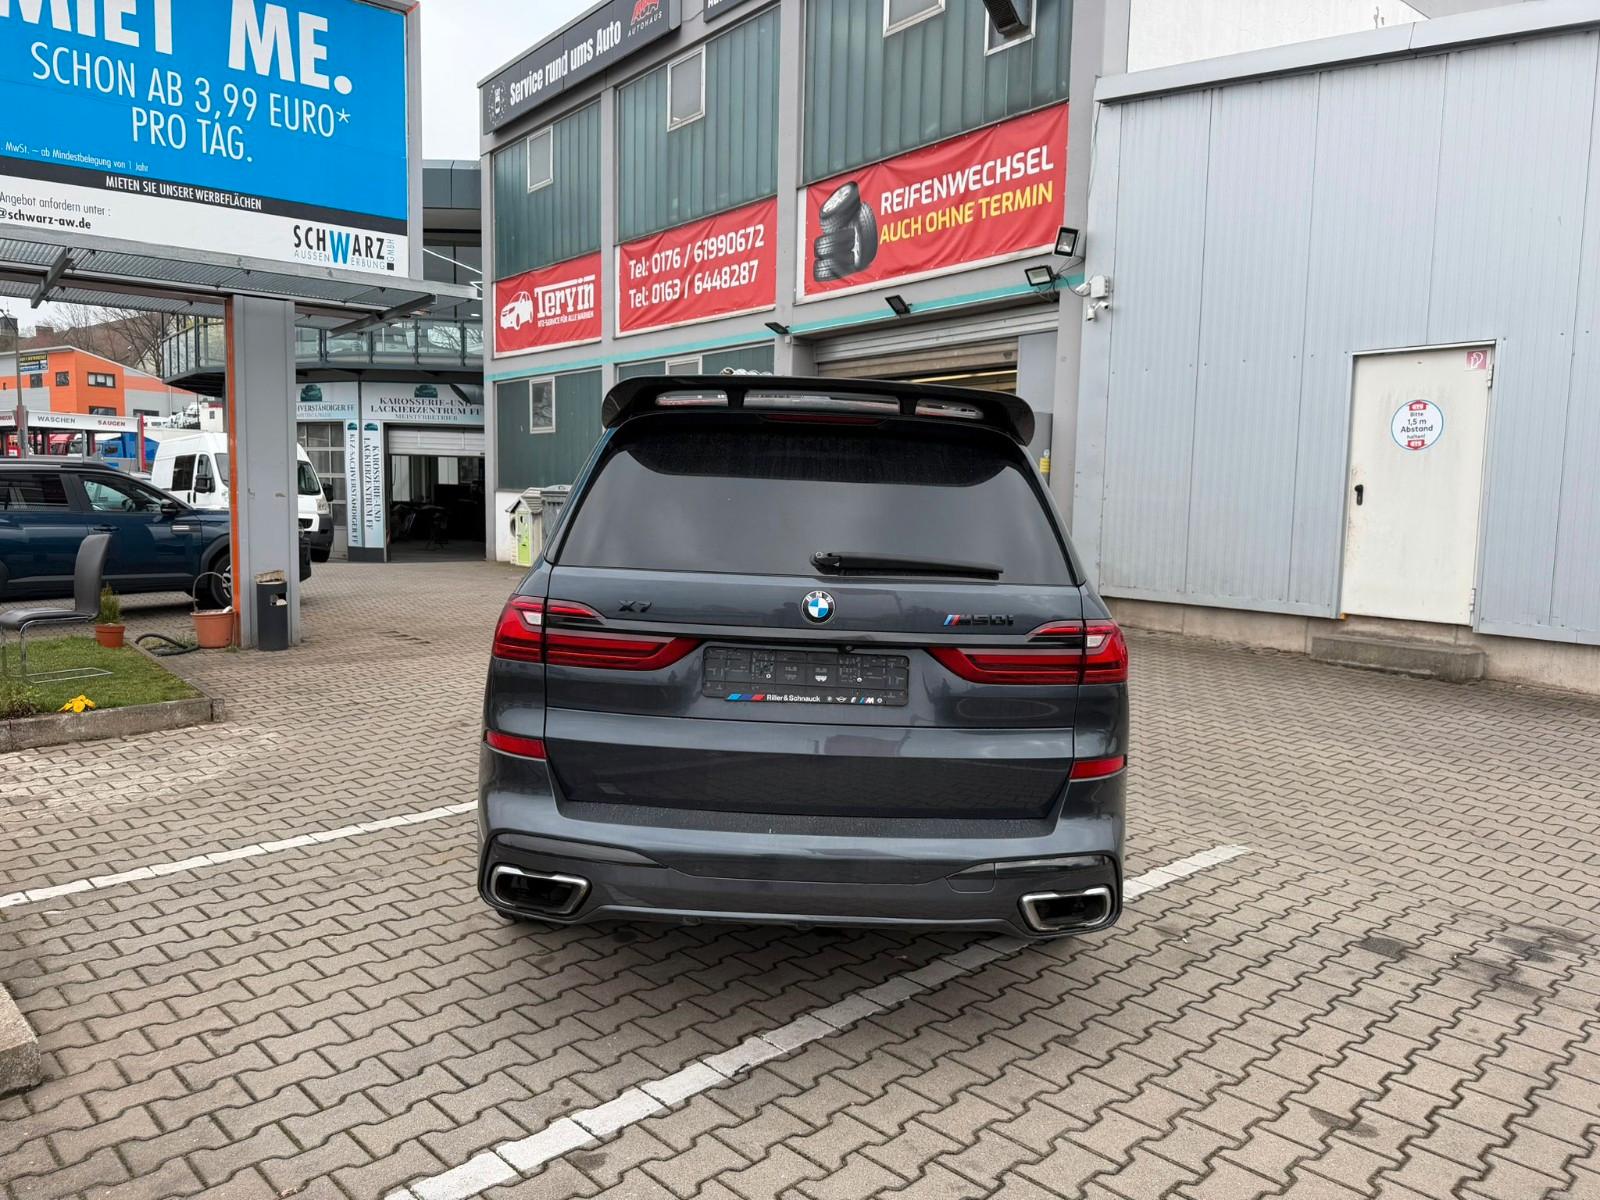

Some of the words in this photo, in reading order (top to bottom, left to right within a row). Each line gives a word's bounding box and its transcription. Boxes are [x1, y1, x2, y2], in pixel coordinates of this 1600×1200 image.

[628, 11, 662, 37] AUTOHAUS
[228, 0, 352, 95] ME.
[510, 69, 543, 106] Service
[545, 51, 568, 85] rund
[570, 37, 593, 72] ums
[596, 20, 621, 57] Auto
[31, 42, 136, 98] SCHON
[148, 68, 183, 107] AB
[195, 77, 257, 121] 3,99
[132, 107, 187, 150] PRO
[197, 118, 252, 162] TAG.
[5, 141, 30, 155] MwSt.
[41, 147, 50, 158] ab
[52, 149, 111, 168] Mindestbelegung
[135, 162, 148, 172] Jahr
[106, 176, 140, 191] MIETEN
[143, 181, 157, 194] SIE
[160, 184, 194, 200] UNSERE
[195, 189, 262, 210] WERBEFLÄCHEN
[881, 145, 1054, 215] REIFENWECHSEL
[0, 192, 36, 206] Angebot
[40, 197, 80, 212] anfordern
[83, 204, 105, 216] unter
[880, 215, 922, 244] AUCH
[925, 202, 975, 233] OHNE
[978, 180, 1053, 219] TERMIN
[293, 225, 385, 264] SCHWARZ
[629, 257, 649, 280] Tel:
[652, 248, 680, 274] 0176
[694, 224, 765, 263] 61990672
[534, 274, 595, 318] Tervin
[629, 286, 649, 309] Tel:
[651, 279, 680, 304] 0163
[694, 259, 758, 295] 6448287
[38, 416, 76, 424] WASCHEN
[371, 405, 466, 415] LACKIERZENTRUM
[1400, 425, 1434, 433] Abstand
[1408, 418, 1418, 426] 1,5
